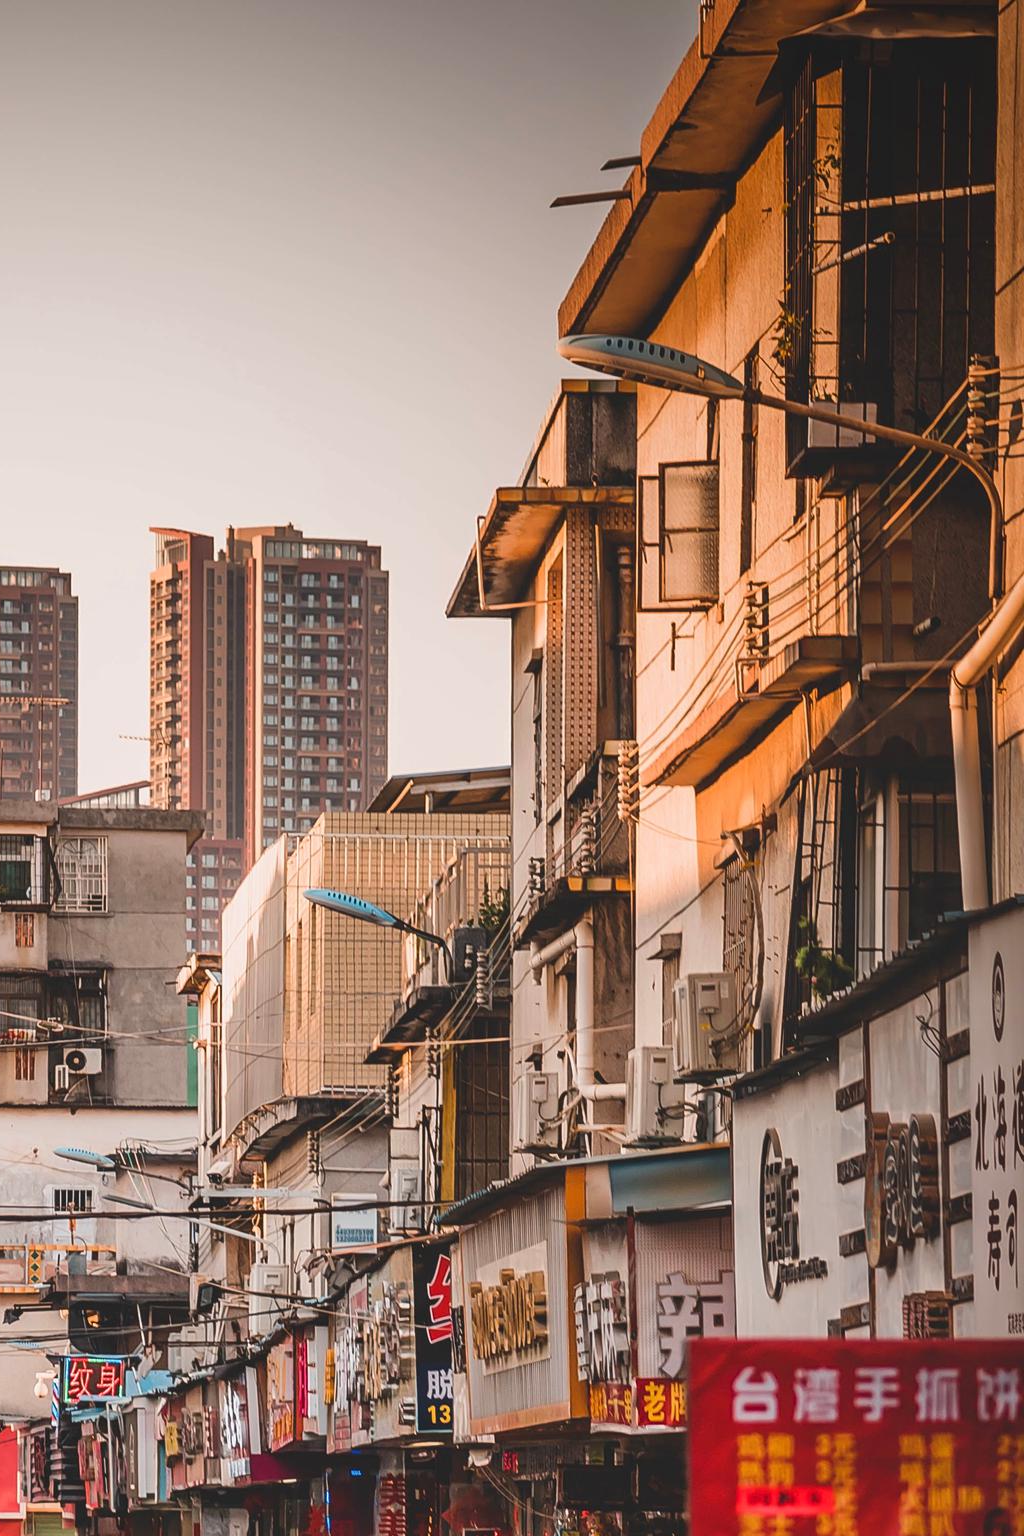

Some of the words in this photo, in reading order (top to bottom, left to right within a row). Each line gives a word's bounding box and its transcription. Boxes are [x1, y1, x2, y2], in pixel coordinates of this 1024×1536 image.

[987, 1188, 1020, 1292] 寿司
[67, 1360, 120, 1398] 纹身
[732, 1366, 1020, 1423] 台湾手抓饼
